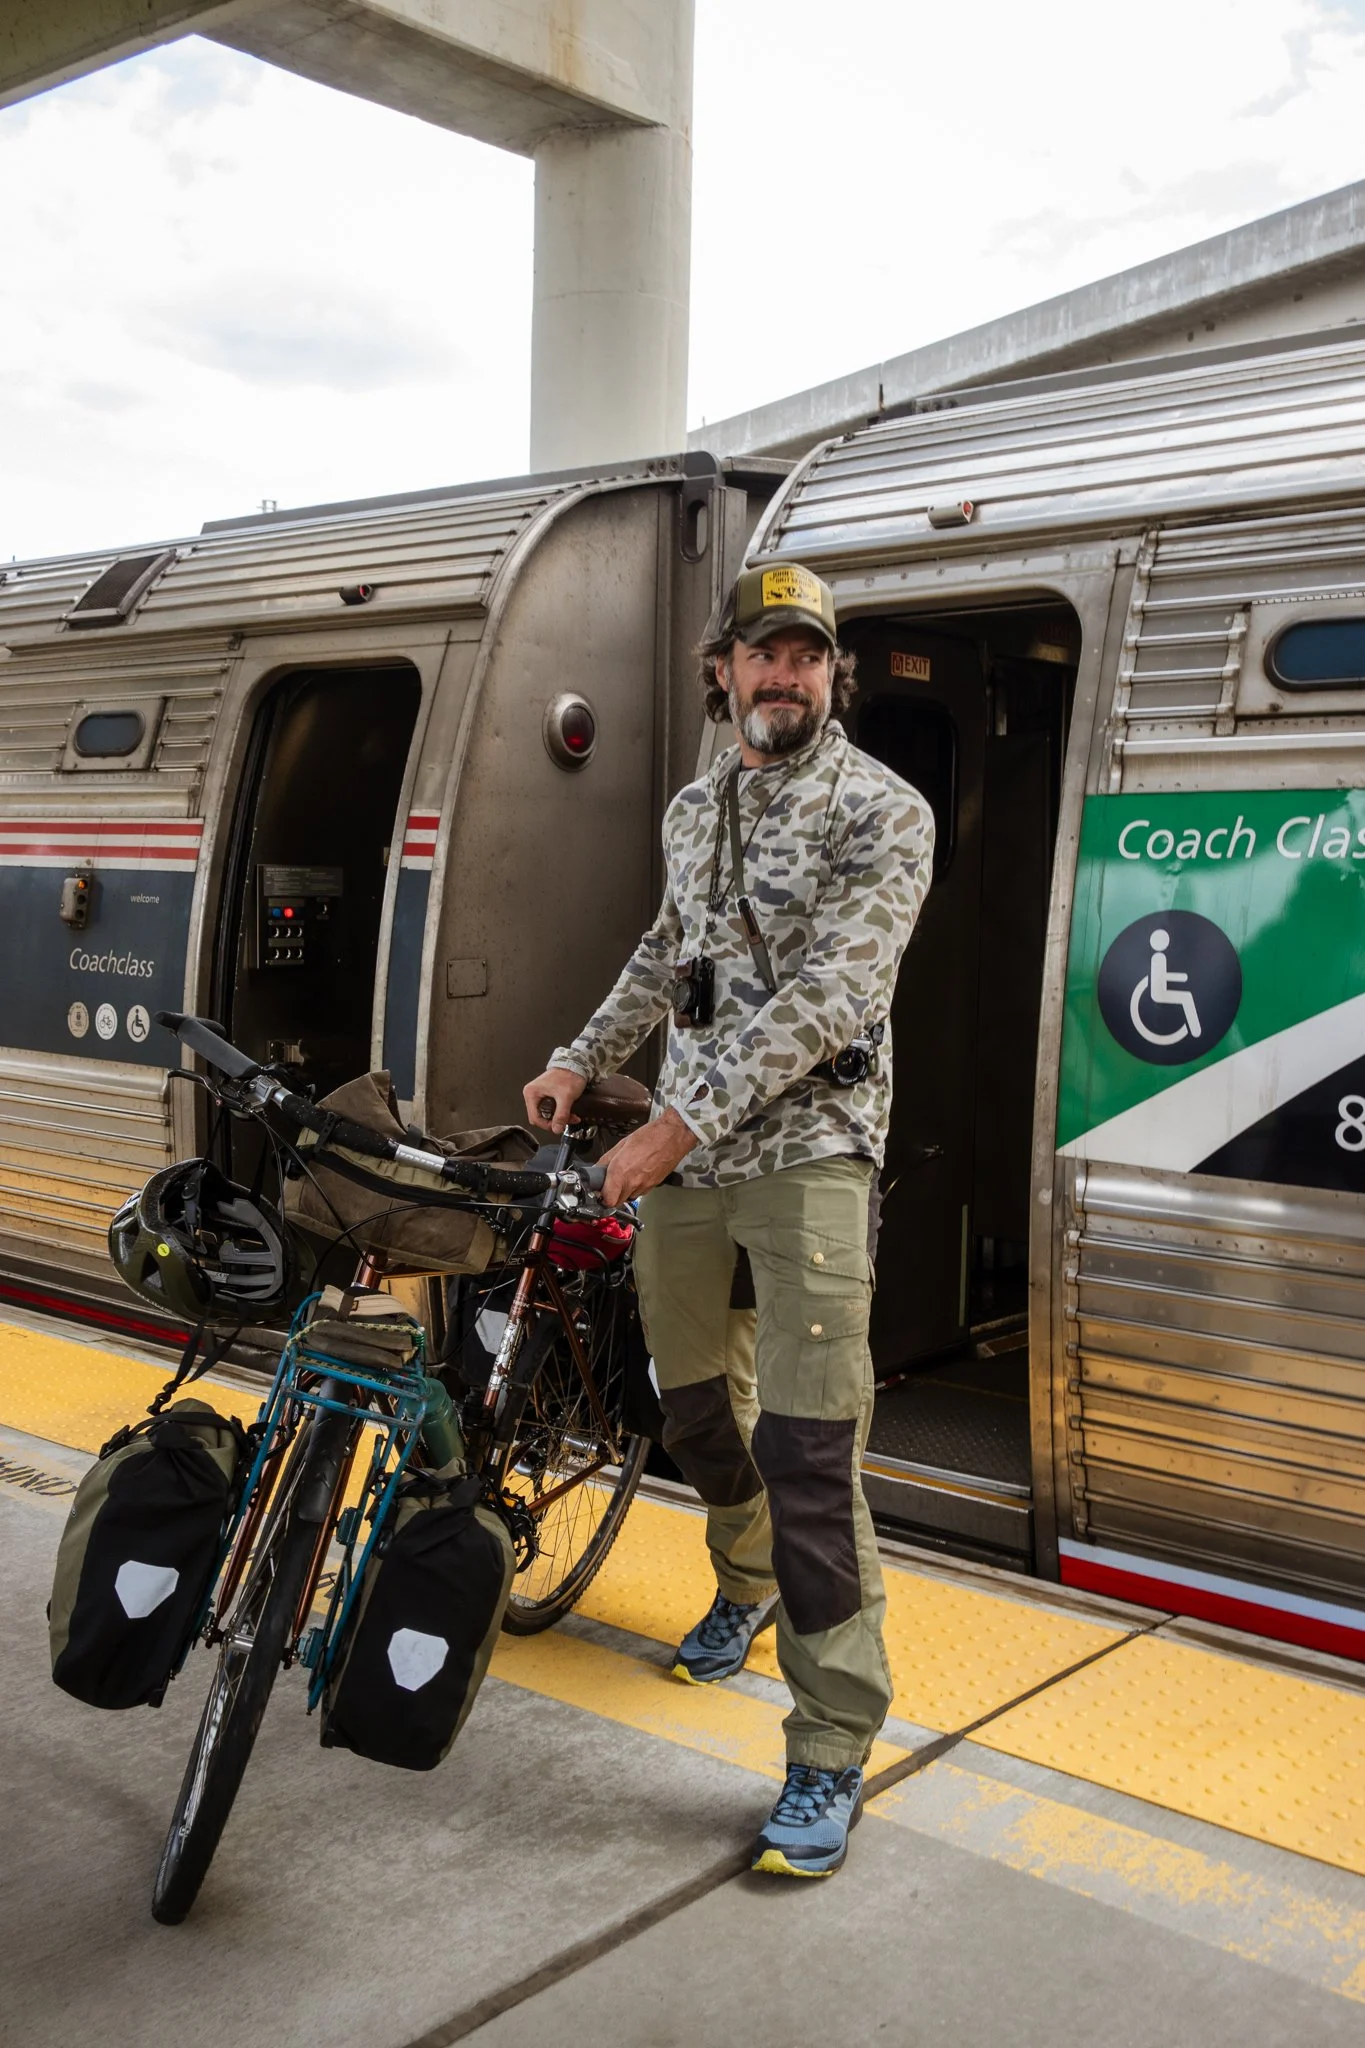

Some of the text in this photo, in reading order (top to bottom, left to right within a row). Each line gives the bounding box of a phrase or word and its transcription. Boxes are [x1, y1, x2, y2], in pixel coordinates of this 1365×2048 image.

[905, 655, 929, 676] EXIT
[1118, 813, 1365, 860] Coach Clas
[130, 893, 160, 904] welcome
[69, 947, 155, 978] Coachclass
[1335, 1094, 1365, 1152] 8
